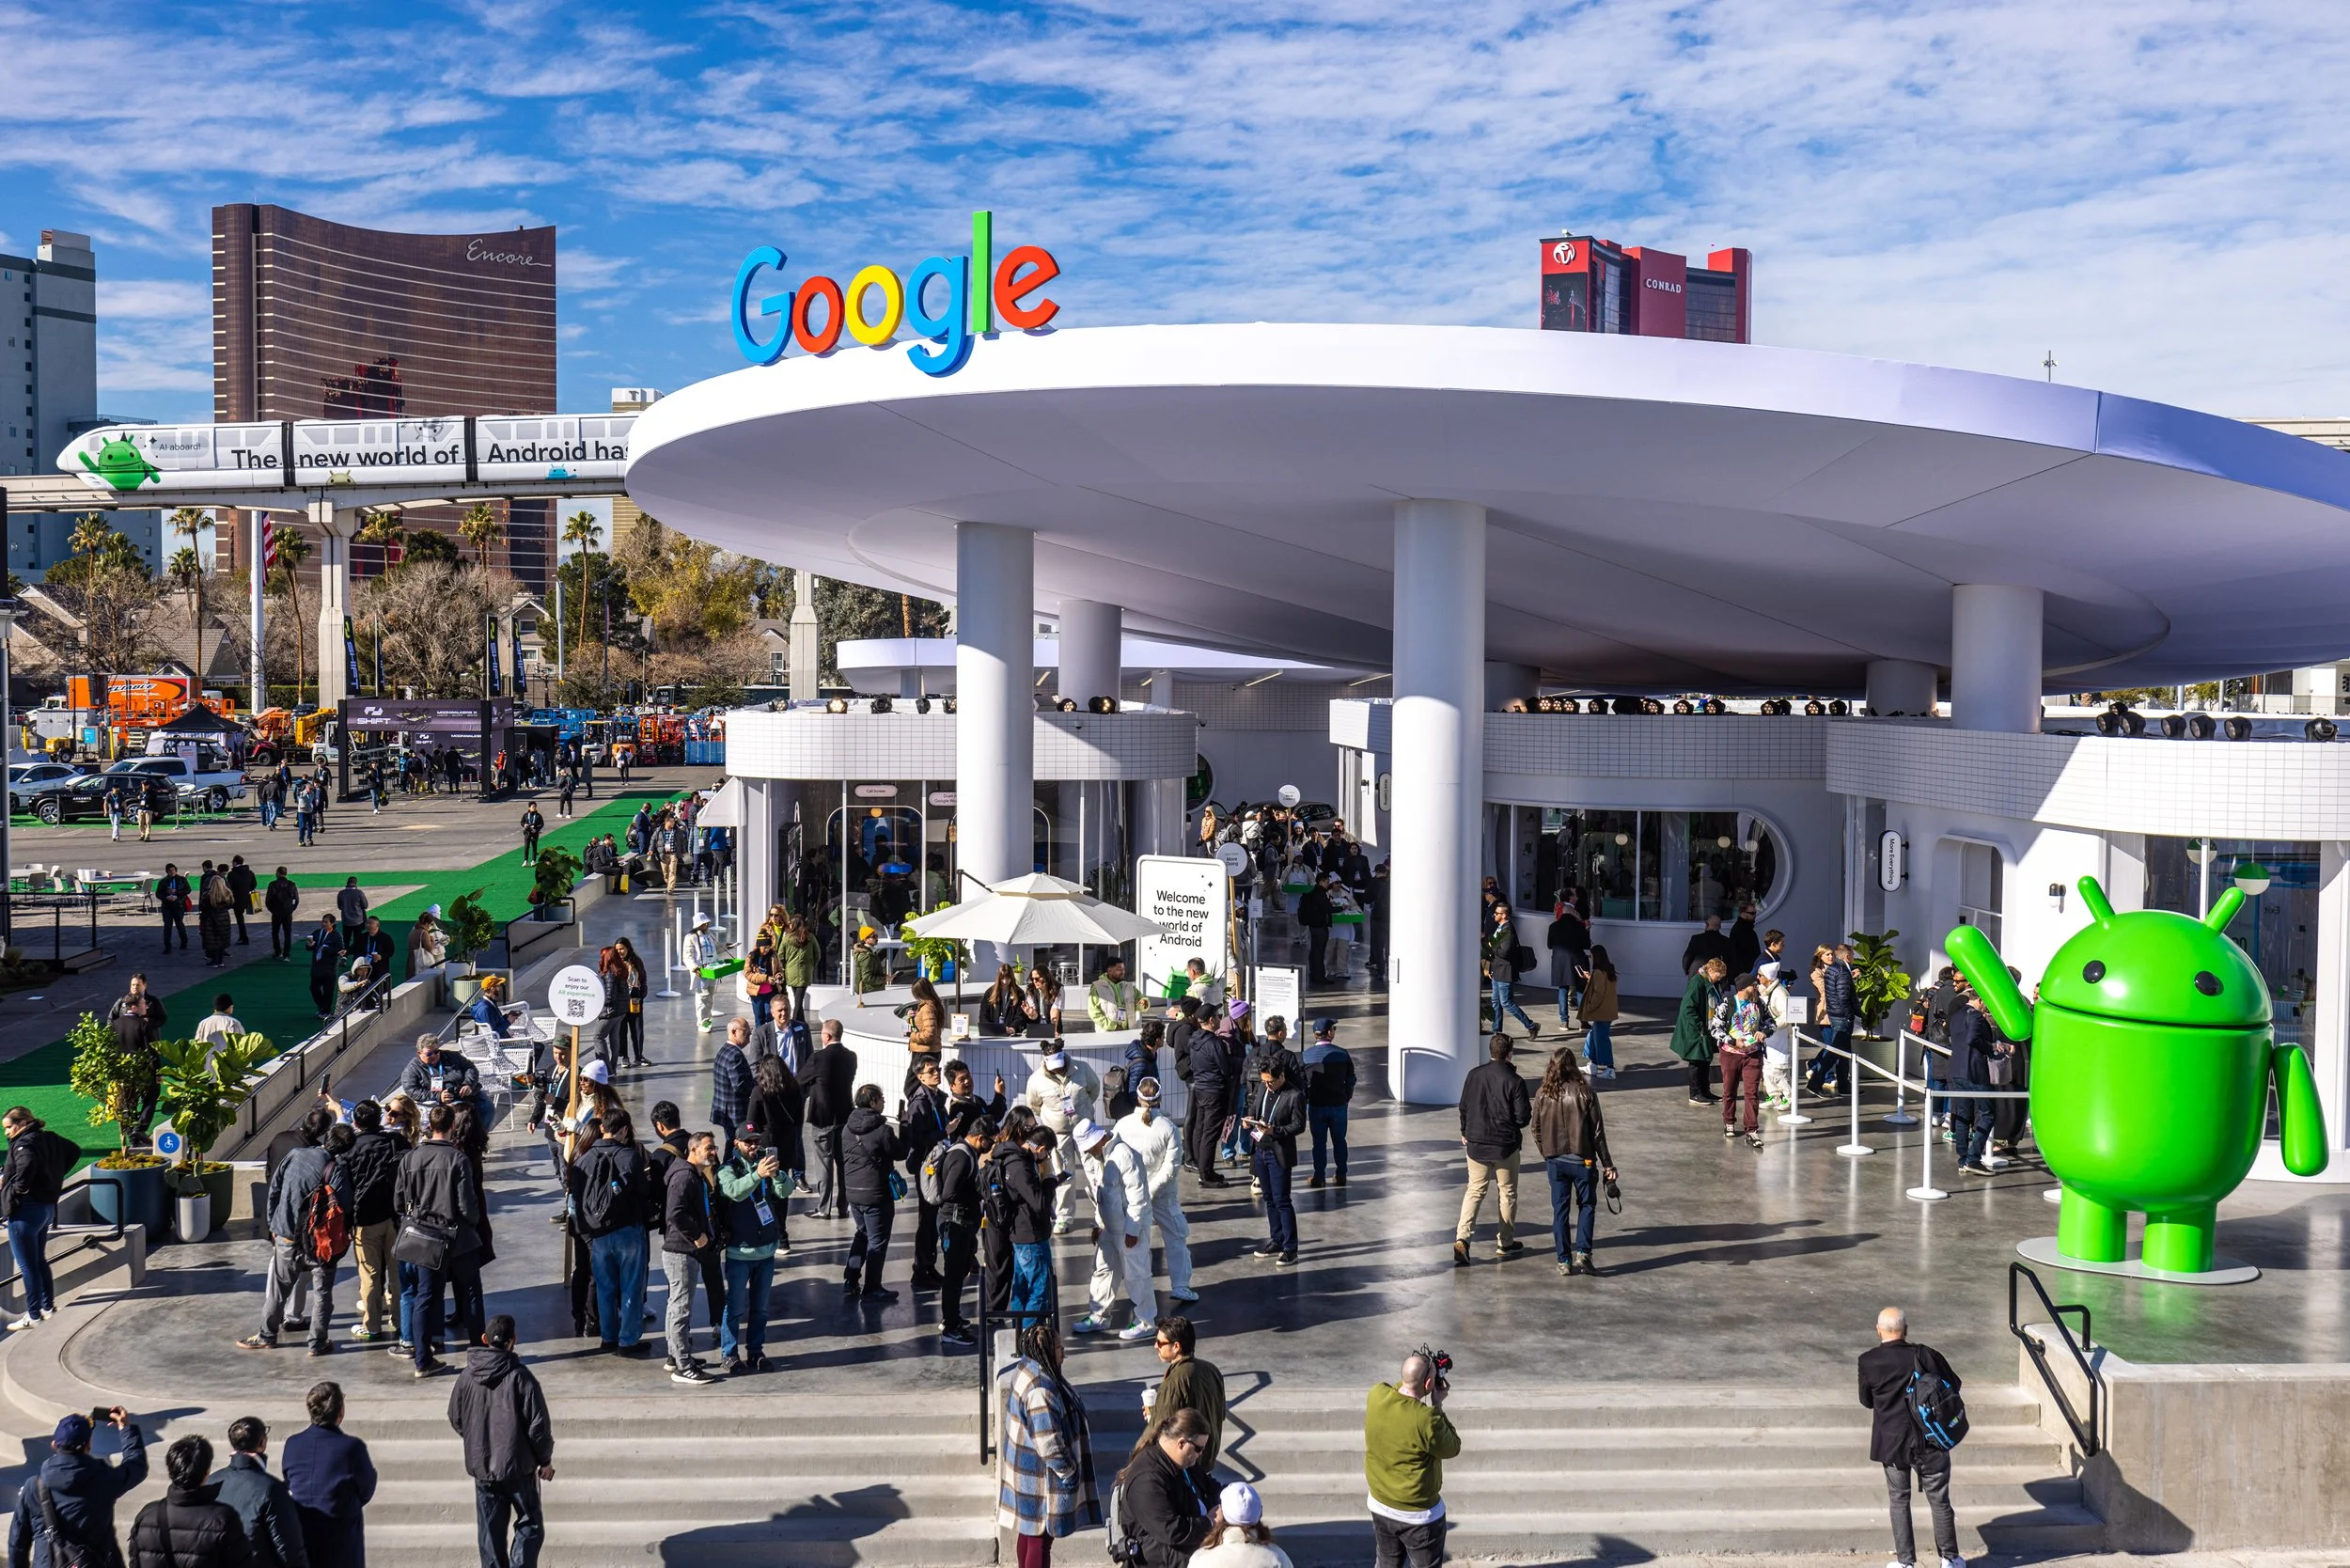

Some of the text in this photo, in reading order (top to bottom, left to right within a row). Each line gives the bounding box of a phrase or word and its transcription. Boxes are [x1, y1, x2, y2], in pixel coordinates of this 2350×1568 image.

[466, 239, 552, 267] Encore
[731, 211, 1060, 377] Google
[1646, 278, 1682, 293] CONRAD
[170, 442, 201, 451] aboard!
[231, 440, 629, 469] The new world of Android ha
[347, 641, 359, 689] SHIFT
[490, 642, 500, 690] SHIFT
[516, 641, 525, 687] SHIFT
[1156, 889, 1206, 904] Welcome
[1153, 905, 1209, 919] to the new
[1191, 922, 1203, 933] of
[1159, 933, 1202, 947] Android
